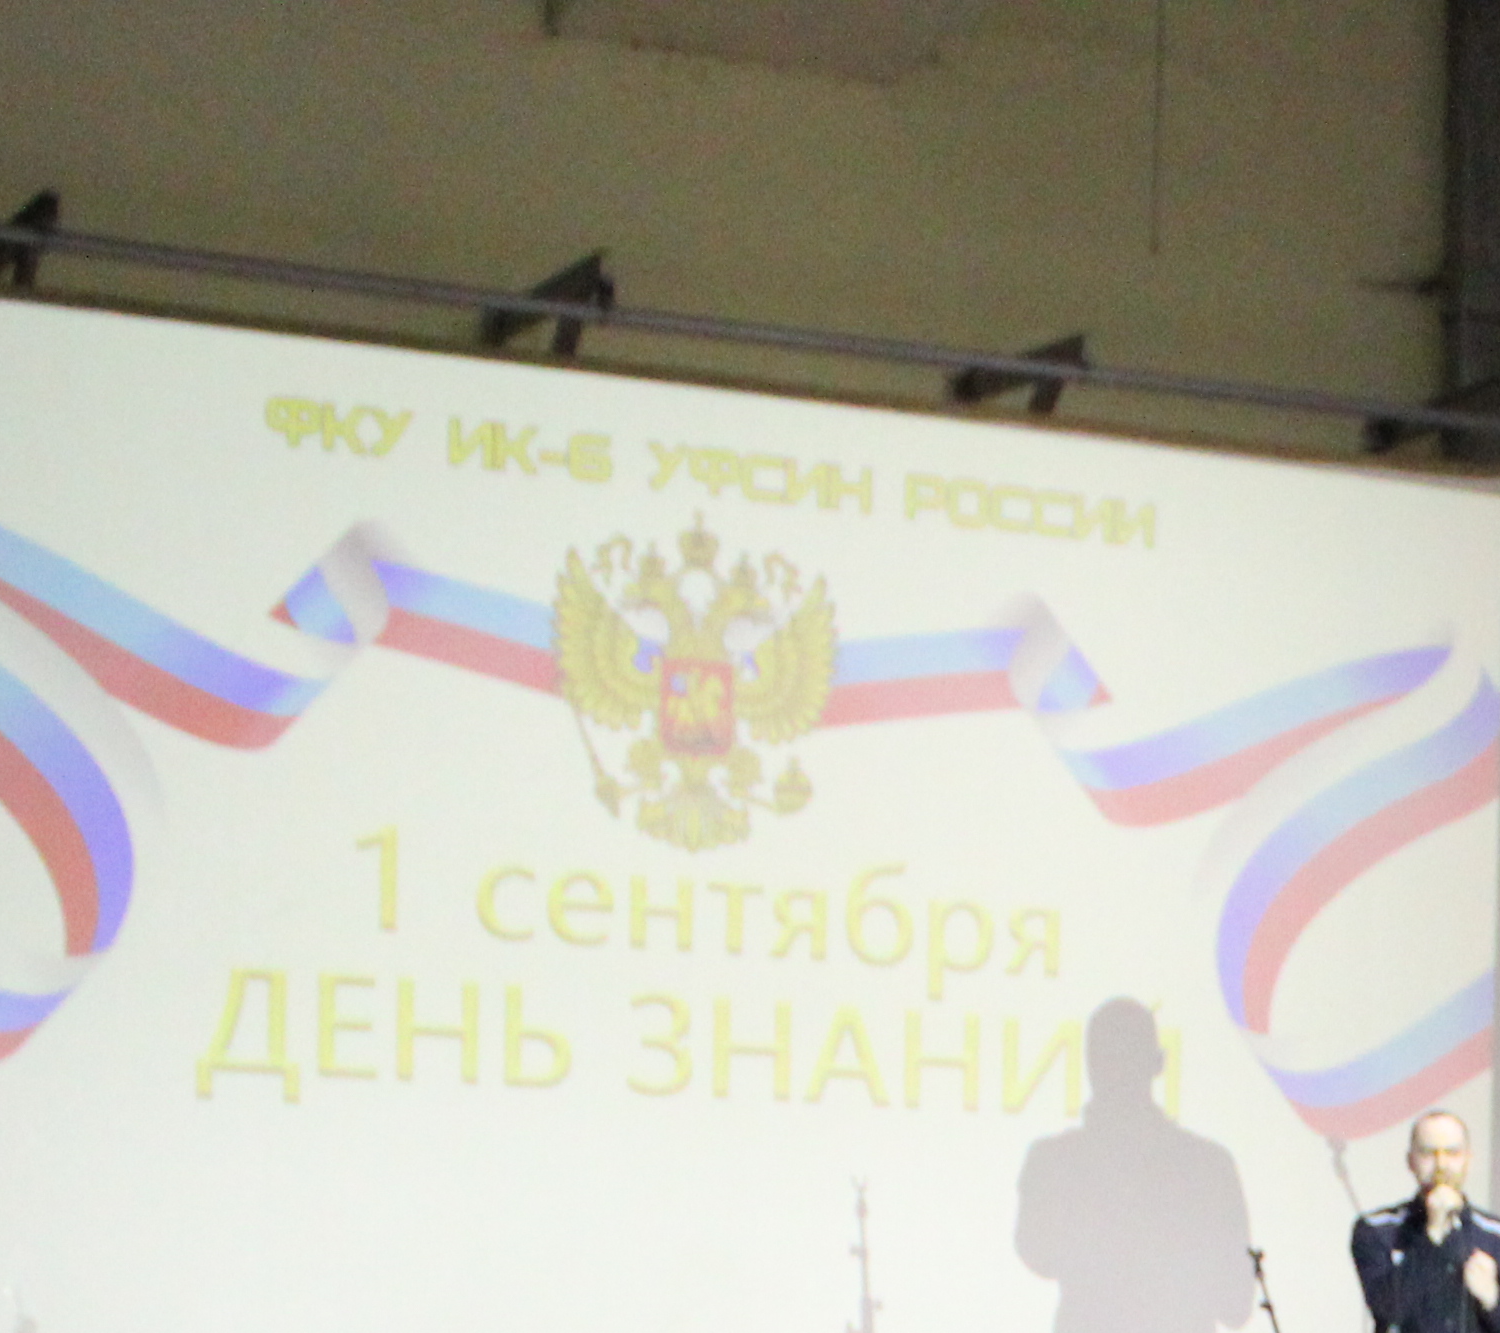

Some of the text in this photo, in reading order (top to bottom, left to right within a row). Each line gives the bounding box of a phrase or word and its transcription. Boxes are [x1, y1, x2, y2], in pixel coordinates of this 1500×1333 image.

[265, 395, 411, 460] ФКУ
[647, 440, 874, 515] УФСИН
[903, 472, 1156, 550] РОССИИ
[353, 823, 1064, 1002] 1 сентября
[194, 965, 574, 1104] ДЕНЬ
